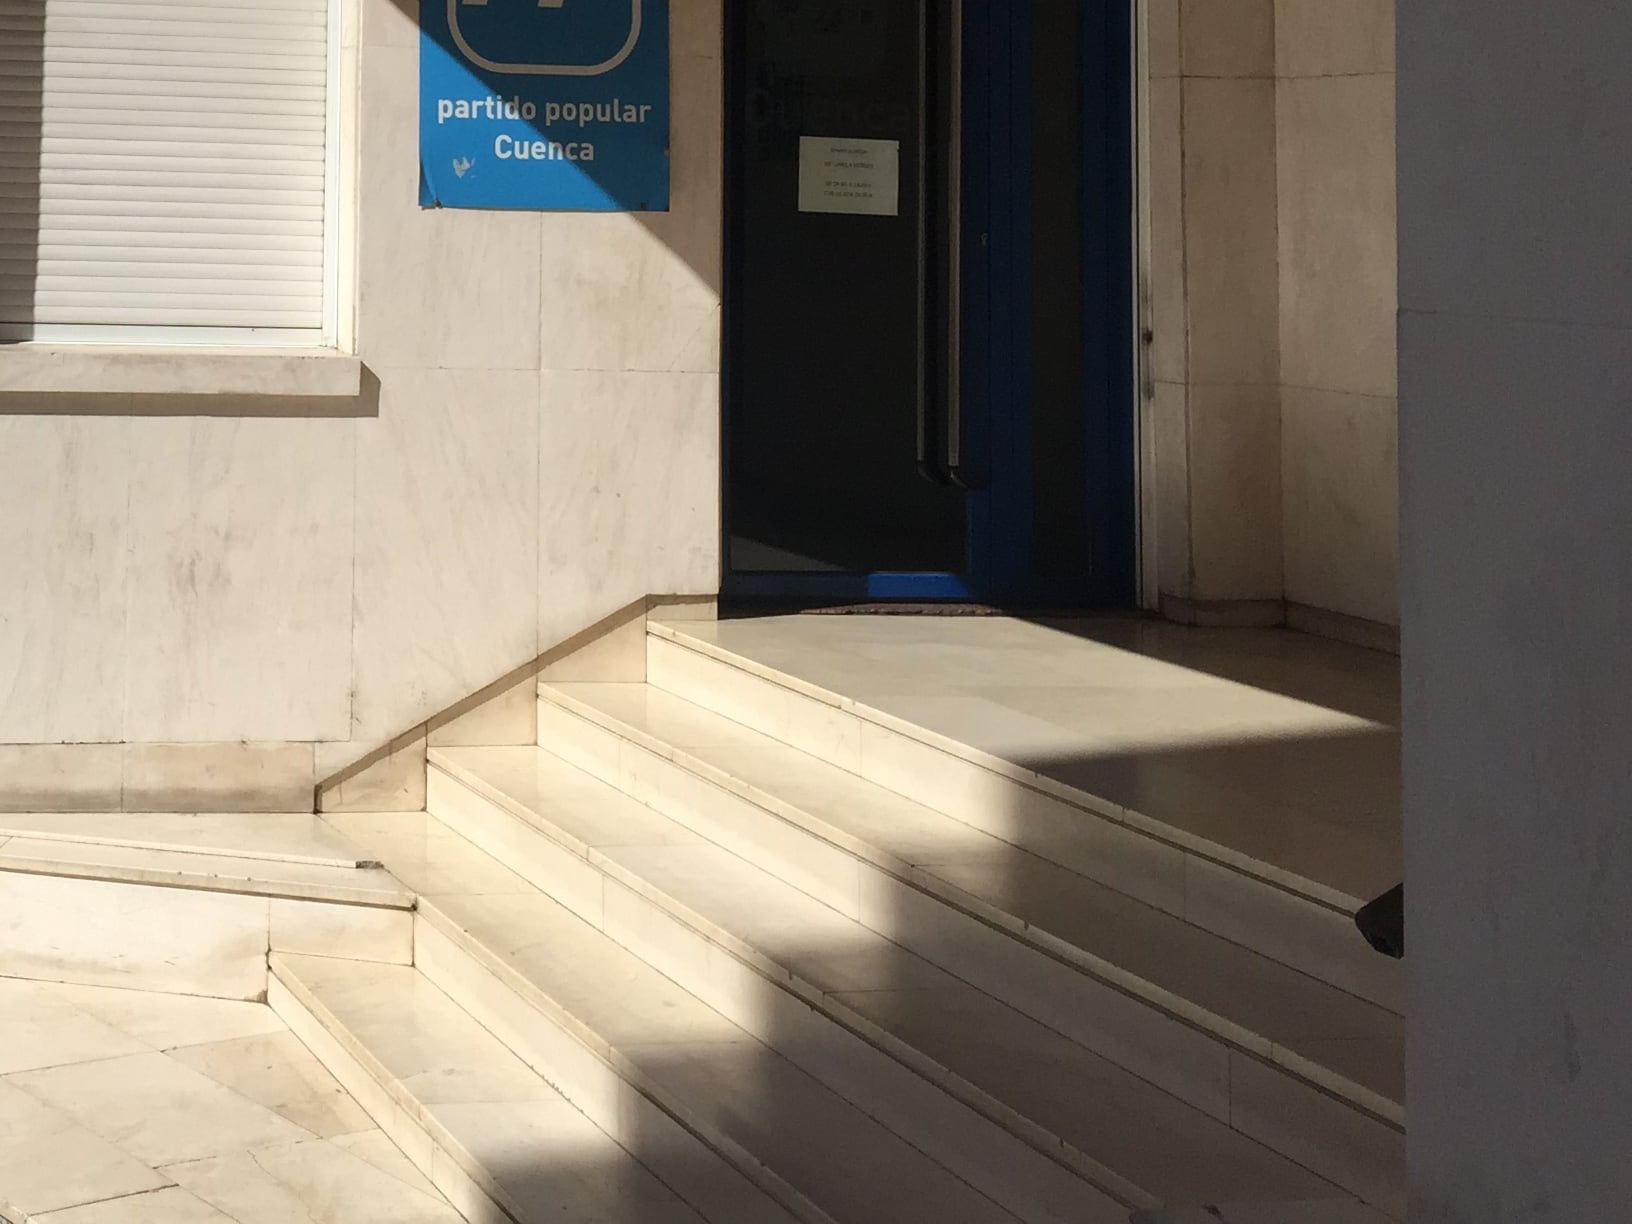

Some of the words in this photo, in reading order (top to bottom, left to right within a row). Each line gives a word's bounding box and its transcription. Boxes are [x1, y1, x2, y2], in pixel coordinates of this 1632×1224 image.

[437, 94, 537, 124] partido
[545, 97, 653, 127] popular
[494, 134, 595, 161] Cuenca
